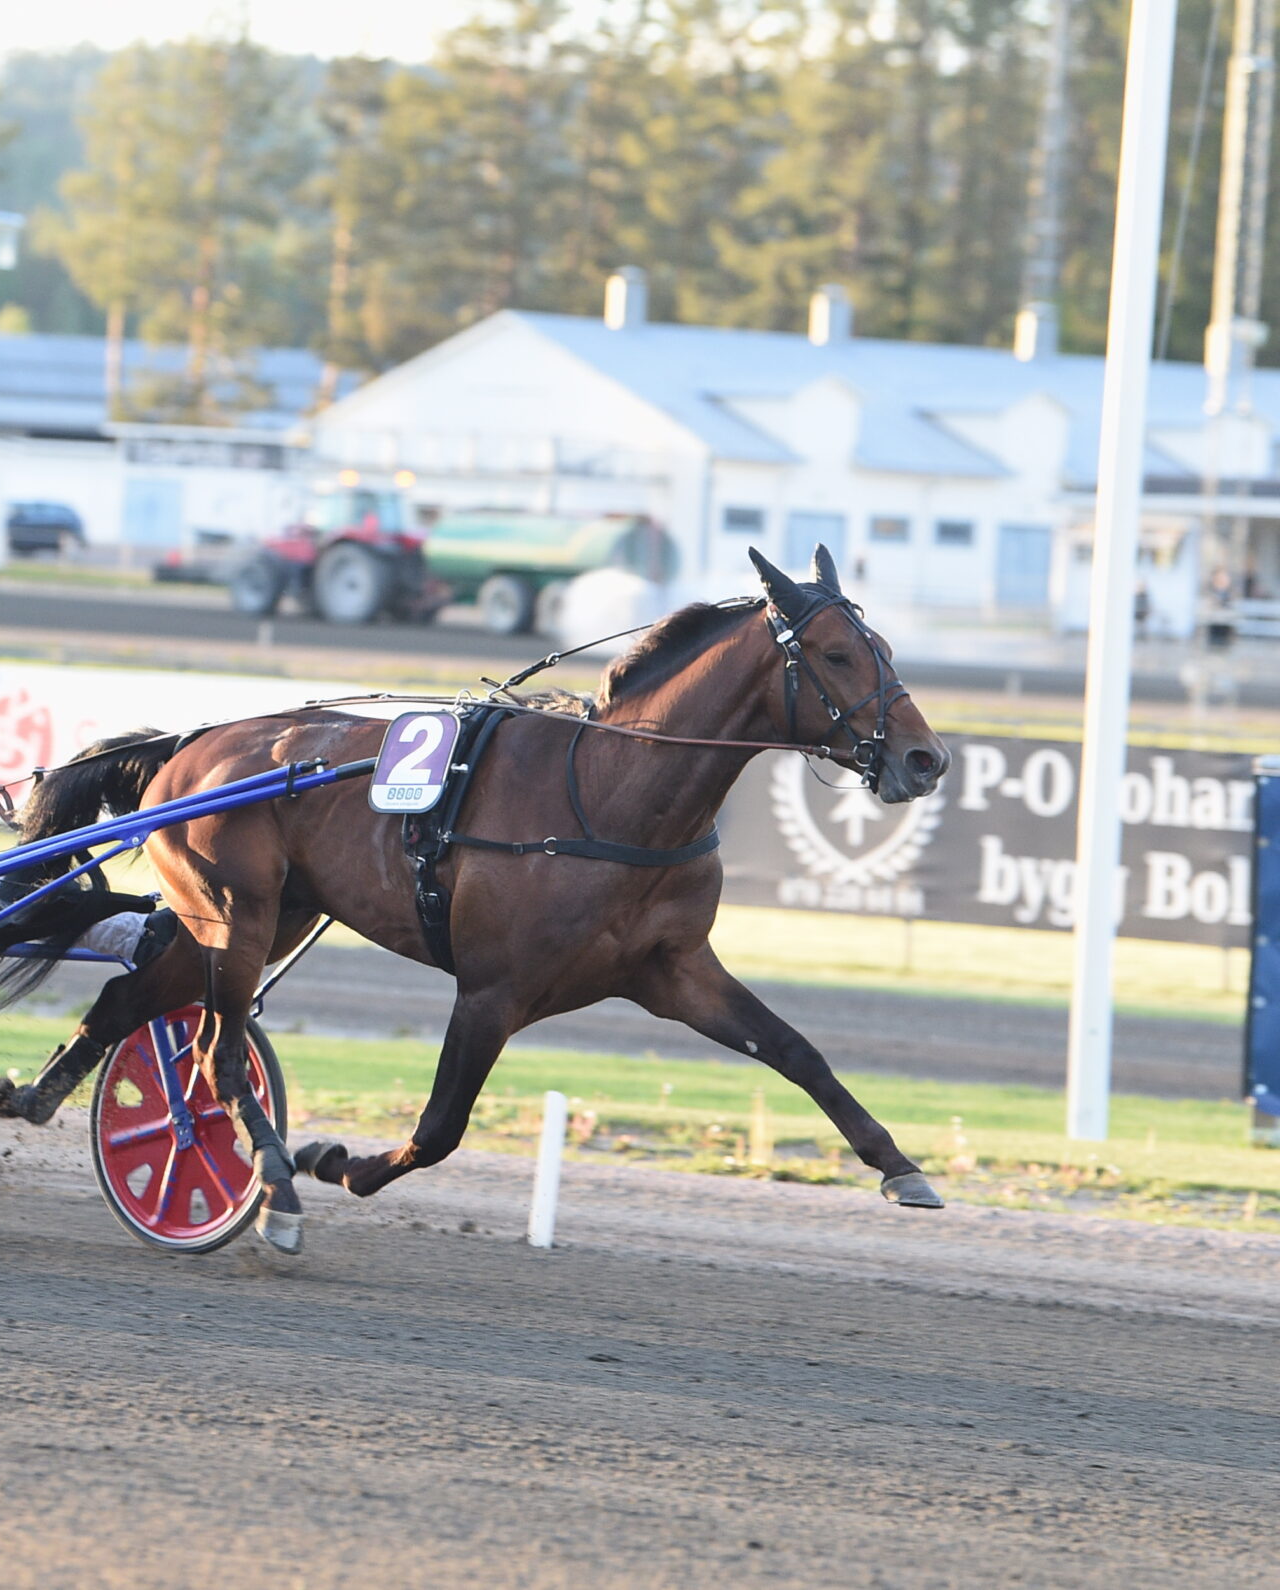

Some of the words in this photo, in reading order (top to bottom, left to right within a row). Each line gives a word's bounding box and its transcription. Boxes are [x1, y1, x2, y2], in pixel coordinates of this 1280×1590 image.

[386, 715, 443, 784] 2
[960, 745, 1074, 817] P-O
[1118, 756, 1255, 832] oha
[1141, 851, 1253, 926] Bol
